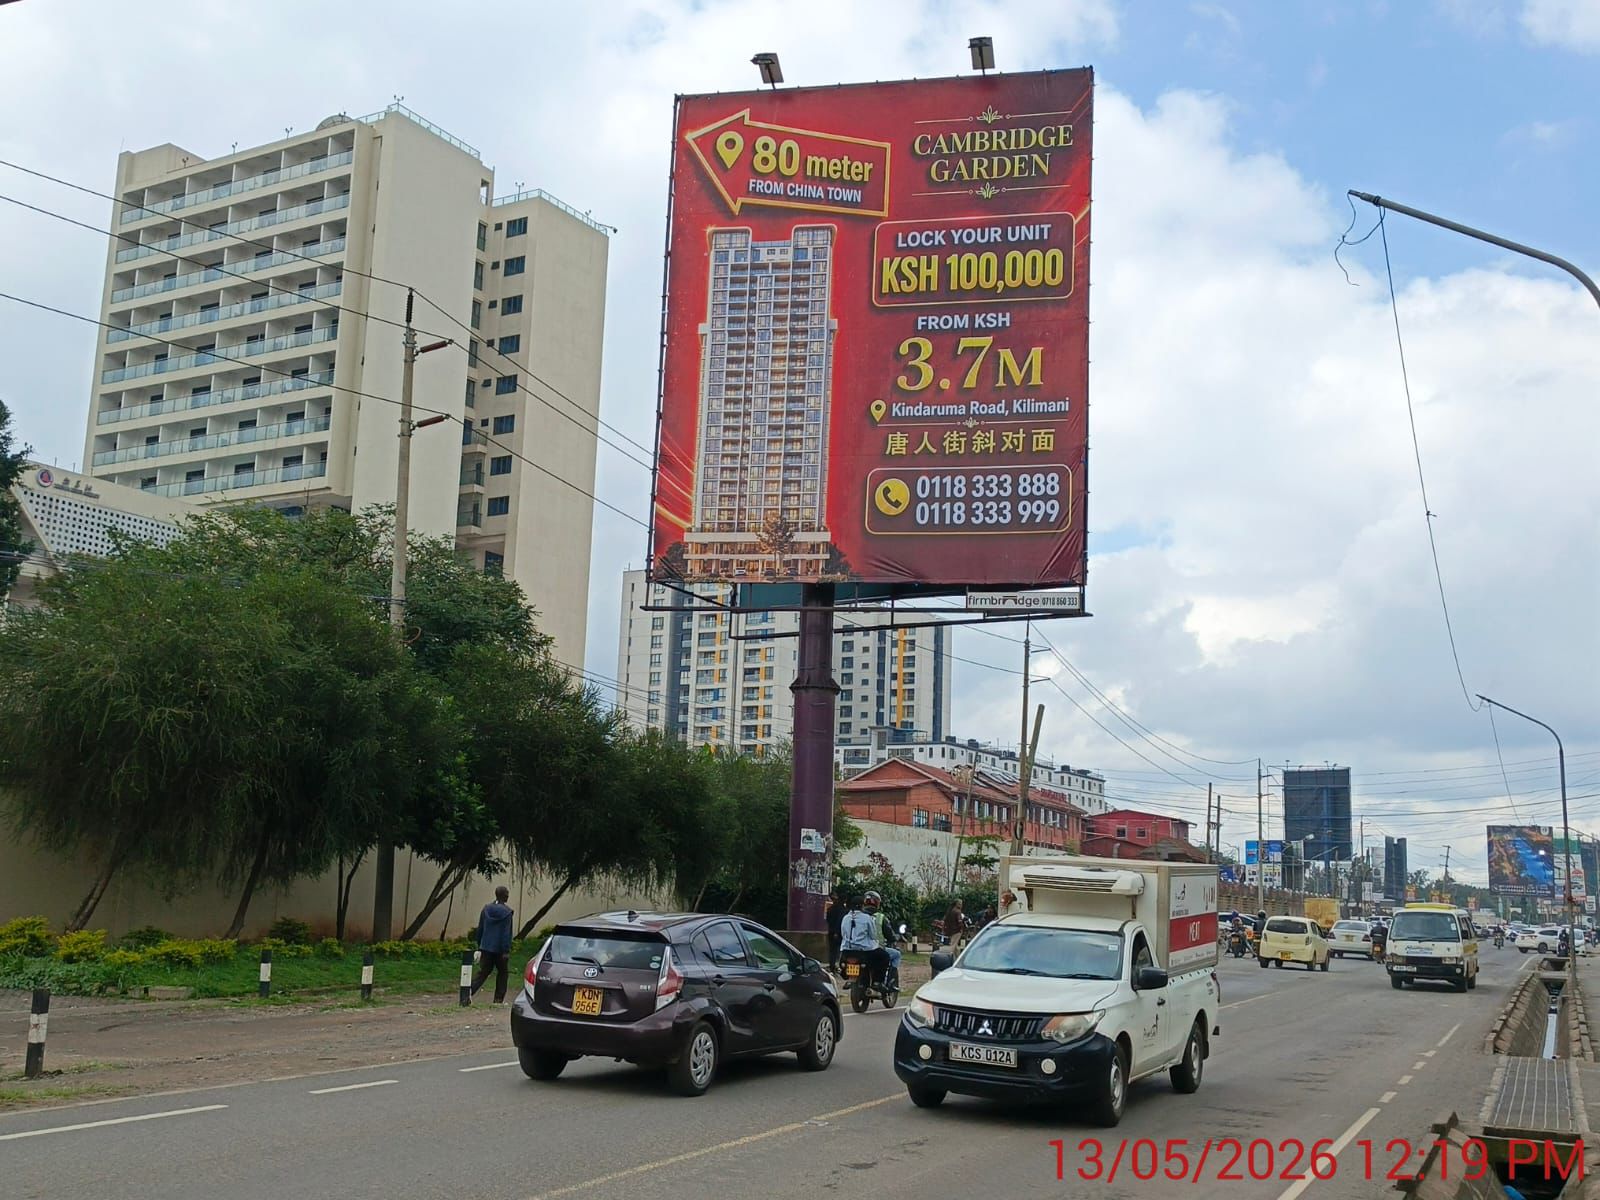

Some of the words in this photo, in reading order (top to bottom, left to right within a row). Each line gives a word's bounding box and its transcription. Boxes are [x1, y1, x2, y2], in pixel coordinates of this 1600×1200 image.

[913, 124, 1074, 156] CAMBRIDGE
[753, 136, 800, 176] 80
[806, 154, 873, 182] meter
[930, 152, 1051, 182] GARDEN
[748, 178, 784, 195] FROM
[786, 182, 825, 199] CHINA
[827, 186, 862, 202] TOWN
[897, 229, 946, 248] LOCK
[950, 227, 1002, 244] YOUR
[1007, 223, 1052, 242] UNIT
[881, 254, 939, 294] KSH
[946, 248, 1064, 294] 100,000
[917, 314, 969, 330] FROM
[974, 312, 1010, 329] KSH
[891, 402, 966, 418] Kindaruma
[969, 400, 1009, 417] Road,
[1012, 396, 1070, 414] Kilimani
[885, 428, 1055, 455] 唐人街斜对面
[916, 475, 967, 499] 0118
[971, 474, 1013, 498] 333
[1017, 472, 1060, 497] 888
[915, 501, 966, 525] 0118
[970, 501, 1012, 525] 333
[1017, 499, 1060, 524] 999
[575, 1001, 598, 1013] 956E
[581, 989, 601, 1001] KDN
[961, 1046, 982, 1060] KCS
[985, 1049, 1012, 1064] 012A
